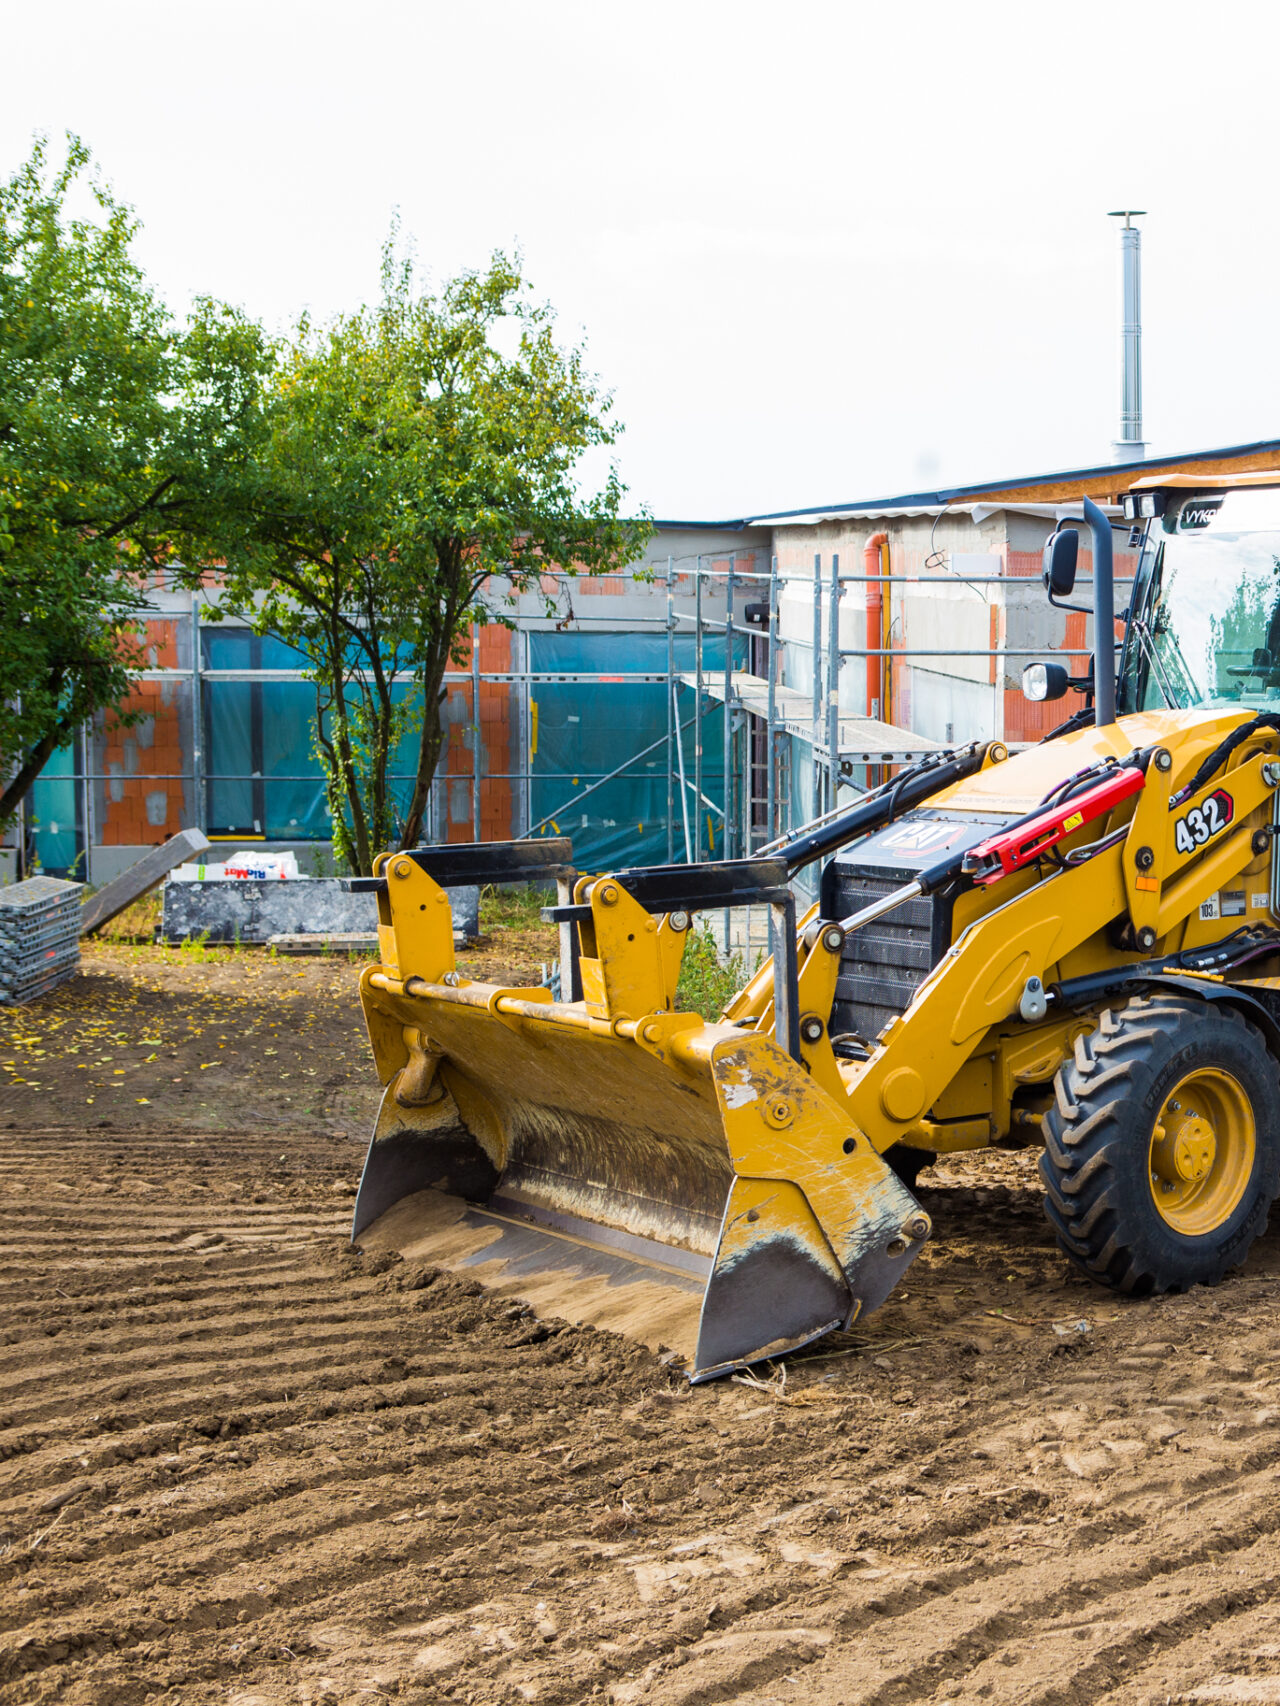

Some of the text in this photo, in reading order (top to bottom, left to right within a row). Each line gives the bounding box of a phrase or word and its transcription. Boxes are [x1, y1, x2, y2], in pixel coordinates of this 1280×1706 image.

[881, 823, 959, 849] CAT
[1175, 797, 1226, 853] 432
[1201, 904, 1213, 917] 103
